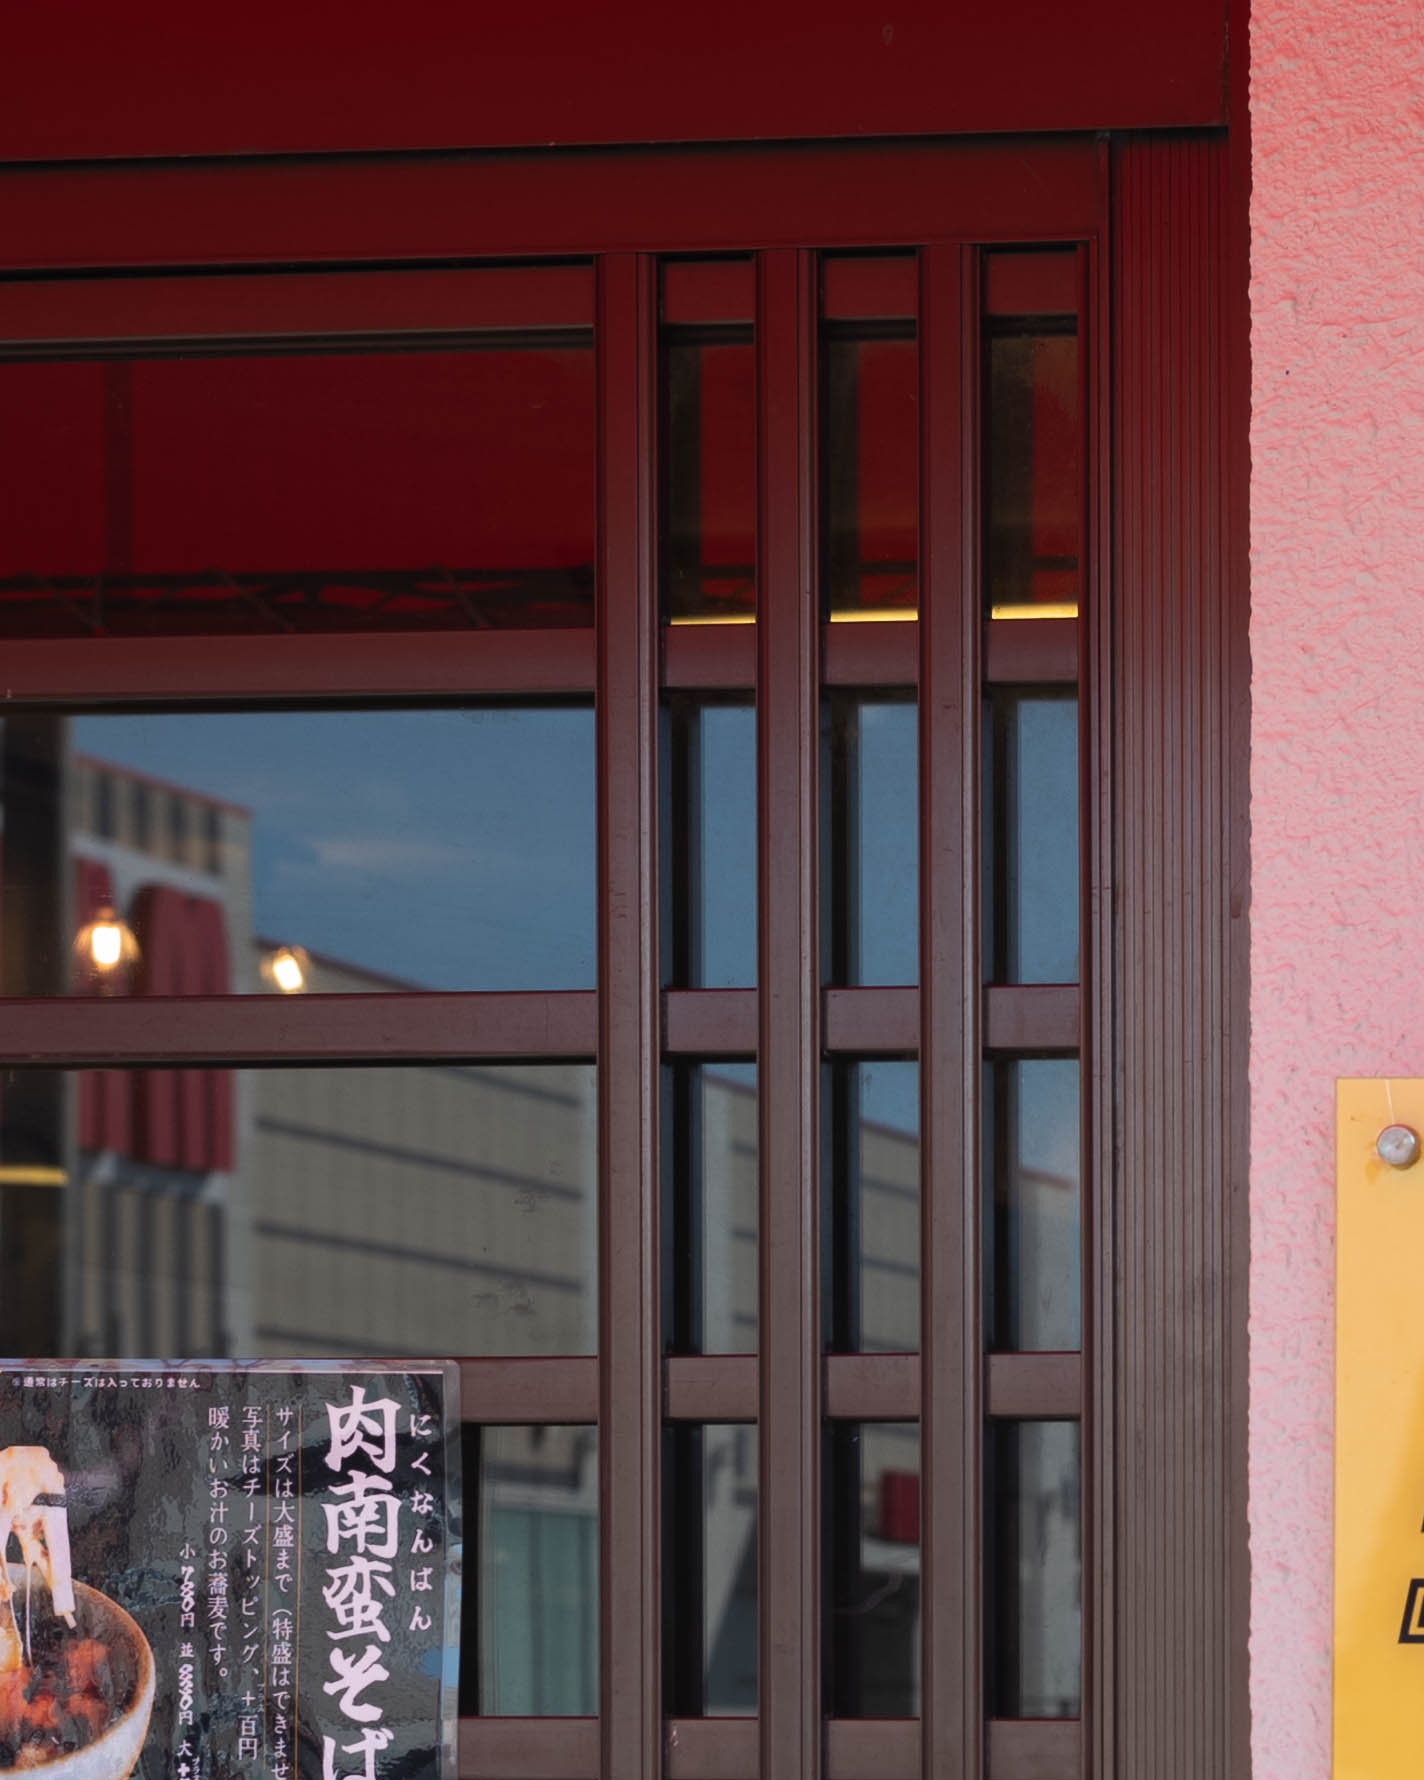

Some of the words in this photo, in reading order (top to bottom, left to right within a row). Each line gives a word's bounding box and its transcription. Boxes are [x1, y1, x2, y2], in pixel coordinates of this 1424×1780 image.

[207, 1406, 230, 1678] 暖かいお汁のお蕎麦です。
[410, 1413, 434, 1632] にくなんばん
